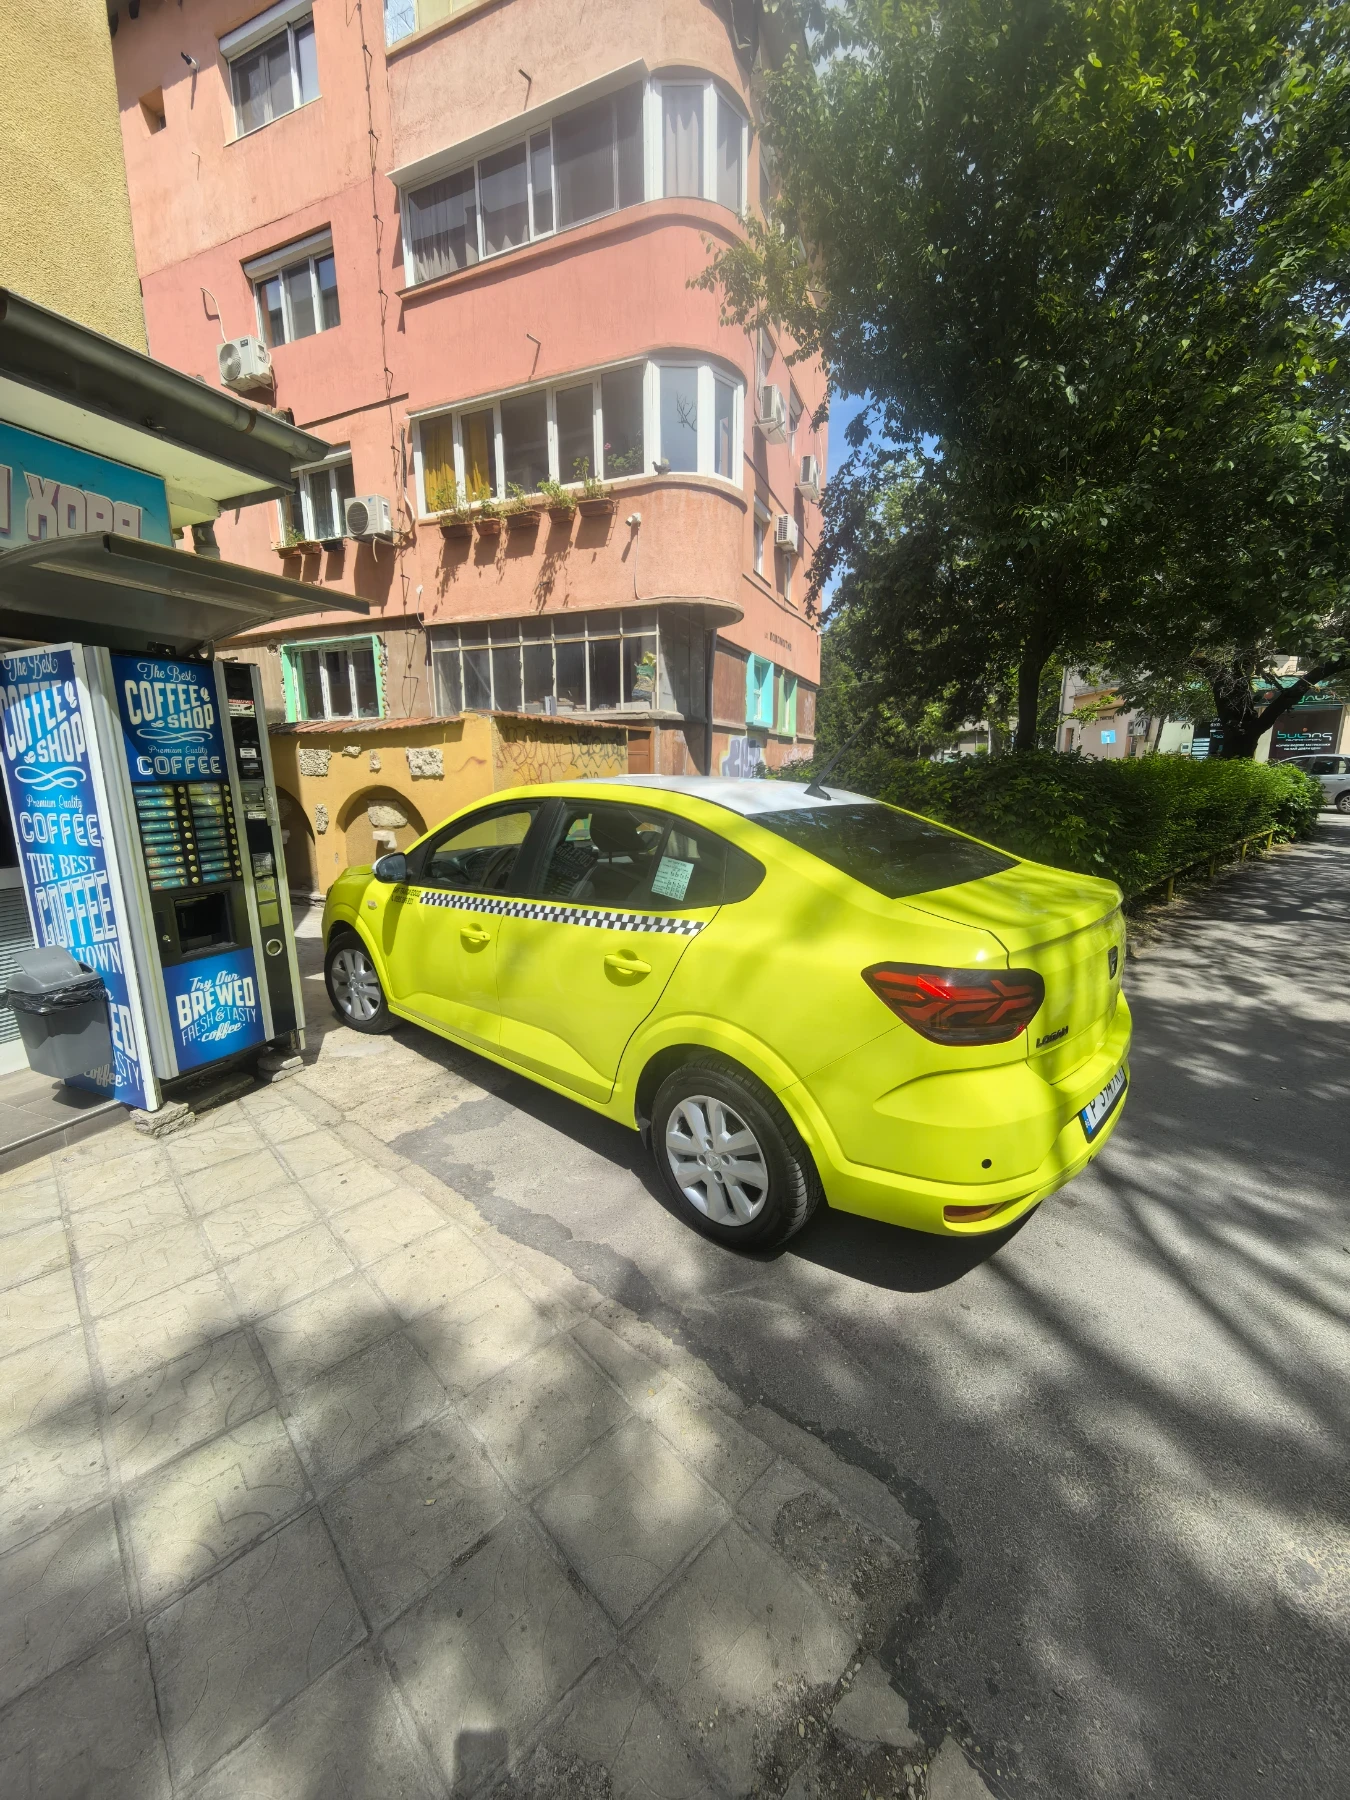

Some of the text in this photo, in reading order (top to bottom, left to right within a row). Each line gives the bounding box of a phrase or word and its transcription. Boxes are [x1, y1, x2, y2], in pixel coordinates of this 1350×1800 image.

[3, 653, 58, 682] The Best
[136, 662, 197, 683] The Best
[124, 679, 201, 726] COFFEE
[167, 703, 215, 730] SHOP
[0, 680, 67, 762] COFFEE
[37, 711, 86, 763] SHOP
[147, 744, 182, 754] Premium
[136, 755, 222, 775] COFFEE
[26, 794, 83, 813] Premium Quality
[20, 811, 102, 848] COFFEE
[26, 852, 97, 885] THE BEST
[34, 870, 118, 948] COFFEE
[75, 941, 123, 975] TOWN
[189, 970, 240, 992] Try Our
[175, 976, 256, 1030] BREWED
[181, 1011, 214, 1047] FRESH
[201, 1020, 243, 1043] coffee
[1036, 1025, 1069, 1049] LOGAN
